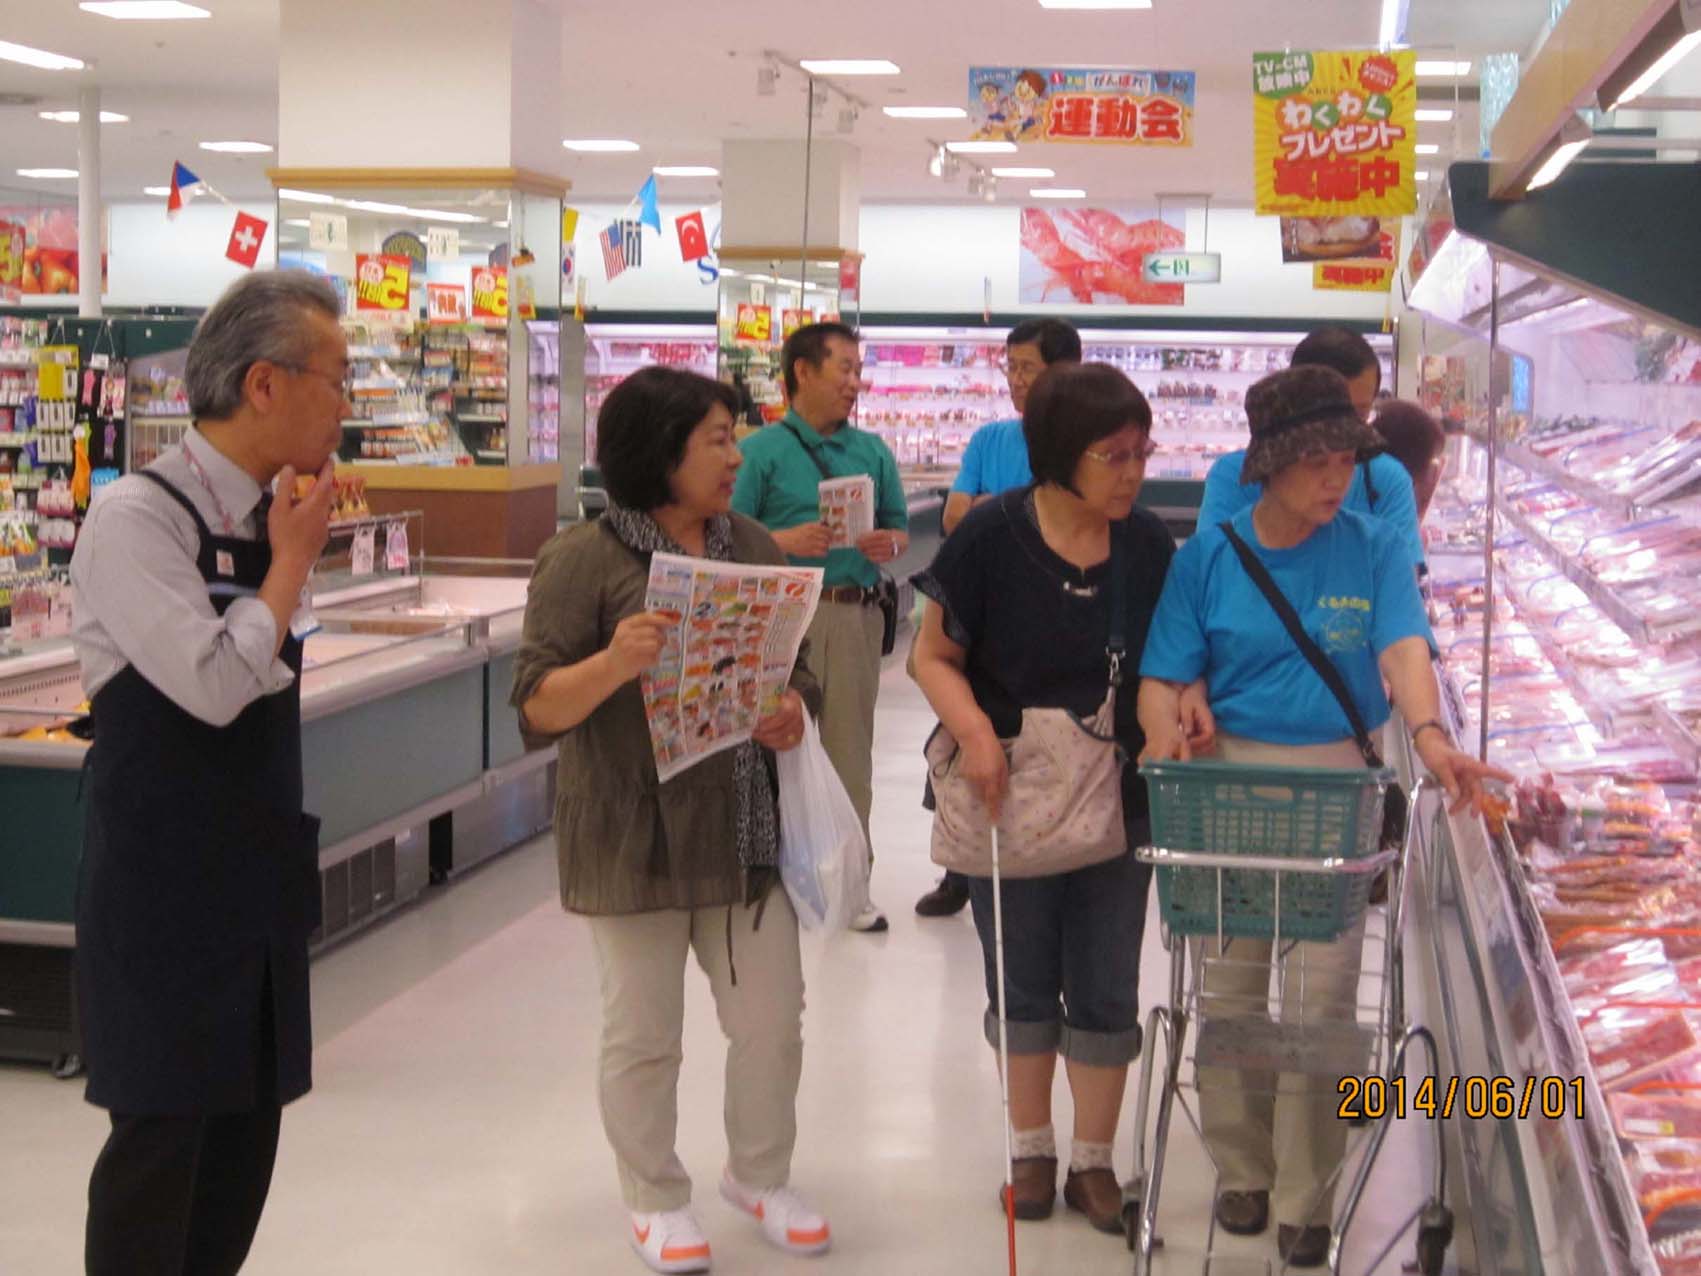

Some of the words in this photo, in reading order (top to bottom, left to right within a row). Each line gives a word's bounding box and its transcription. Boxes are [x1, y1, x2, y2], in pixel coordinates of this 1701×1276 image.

[1254, 55, 1308, 75] TV-CM
[1048, 97, 1181, 141] 運動会
[1281, 90, 1387, 129] わくわく
[1280, 121, 1403, 161] プレゼント
